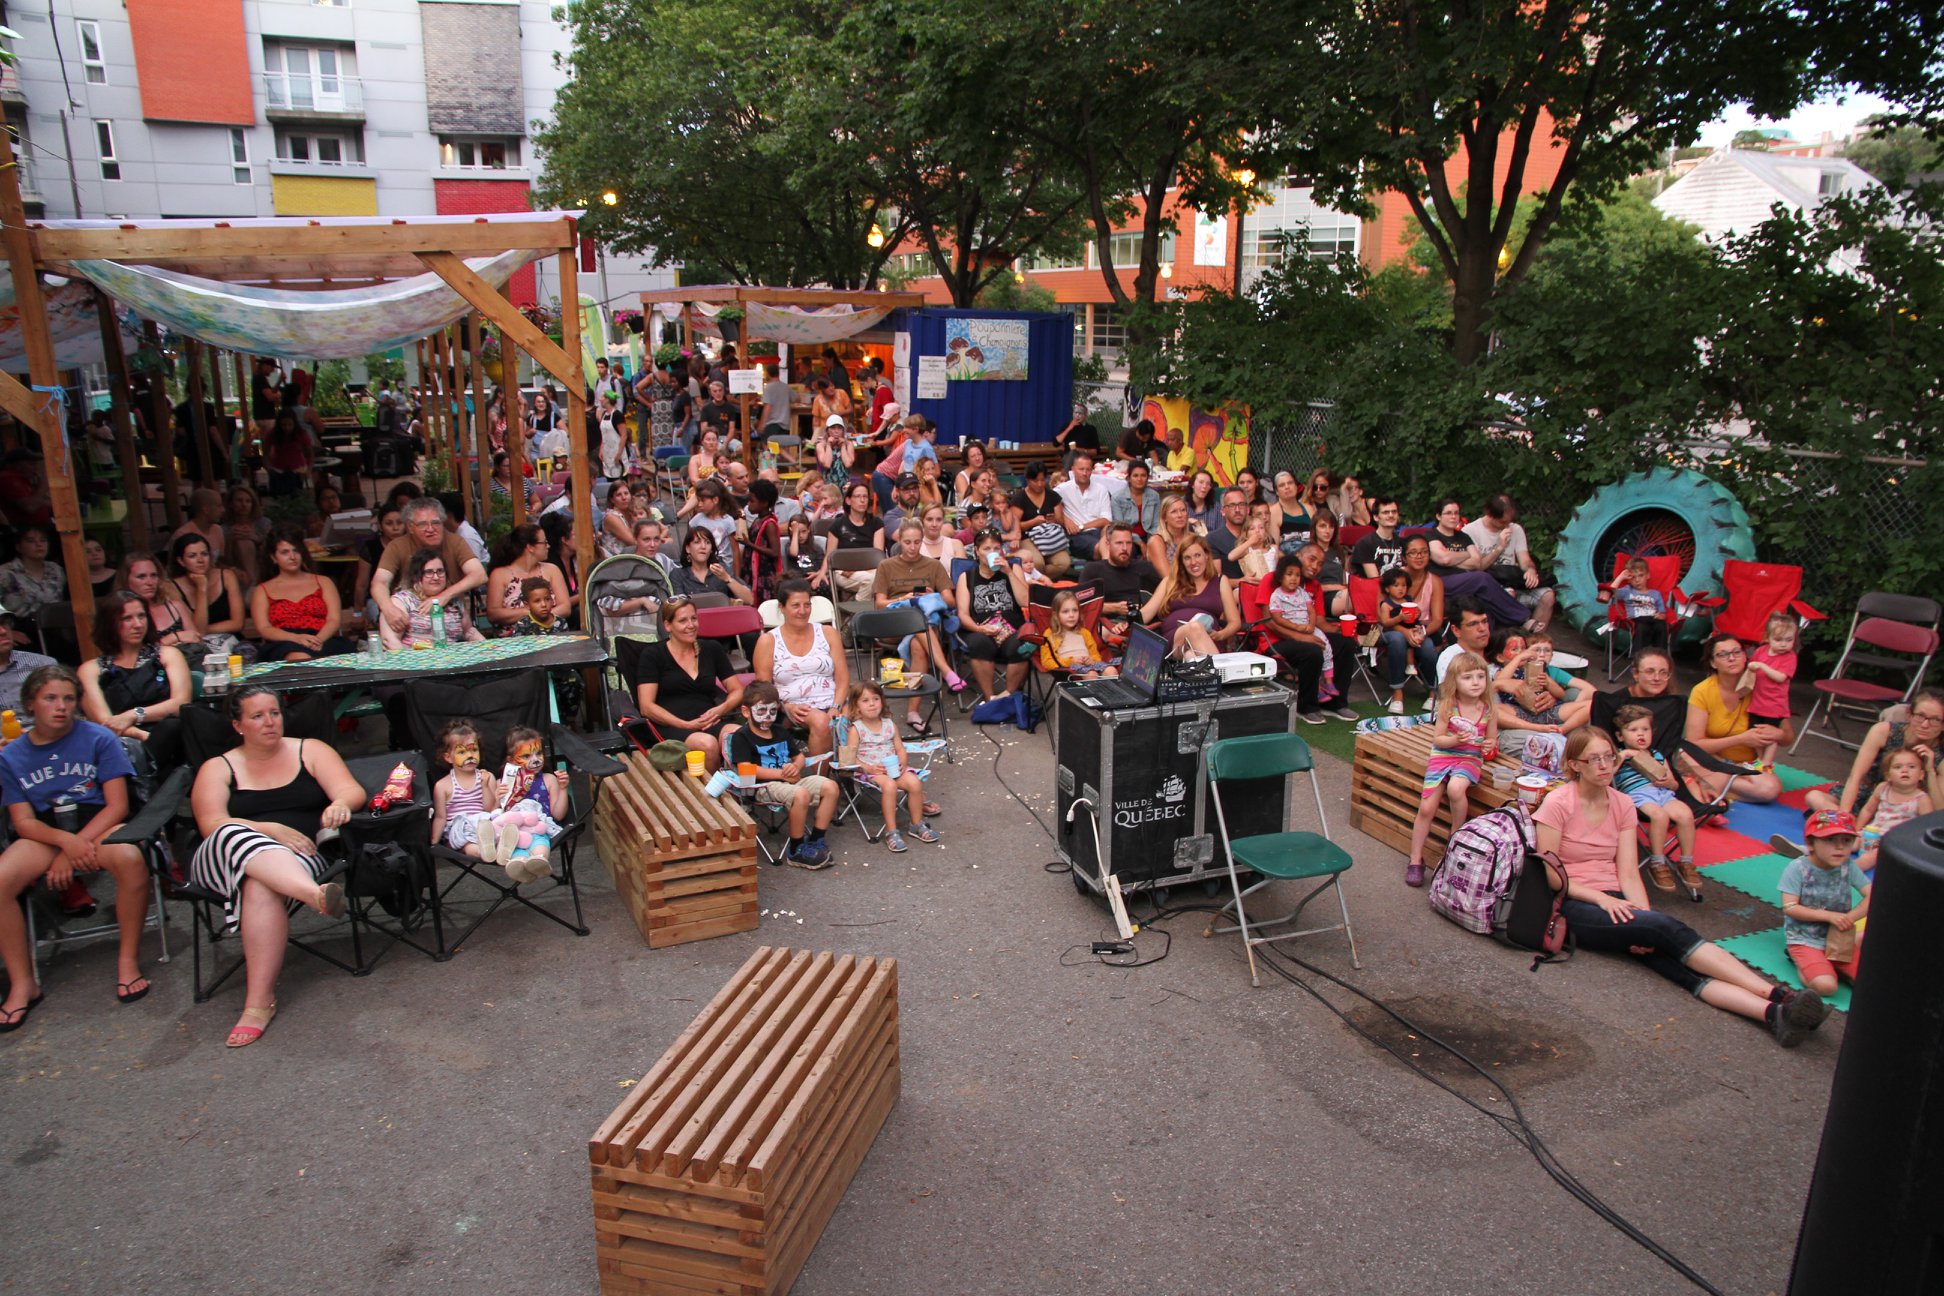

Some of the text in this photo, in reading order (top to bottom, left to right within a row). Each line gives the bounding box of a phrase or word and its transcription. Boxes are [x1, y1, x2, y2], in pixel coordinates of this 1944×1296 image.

[19, 762, 97, 790] LUE JAYS
[1114, 804, 1186, 828] QUÉBEC
[1115, 798, 1153, 810] VILLE DE
